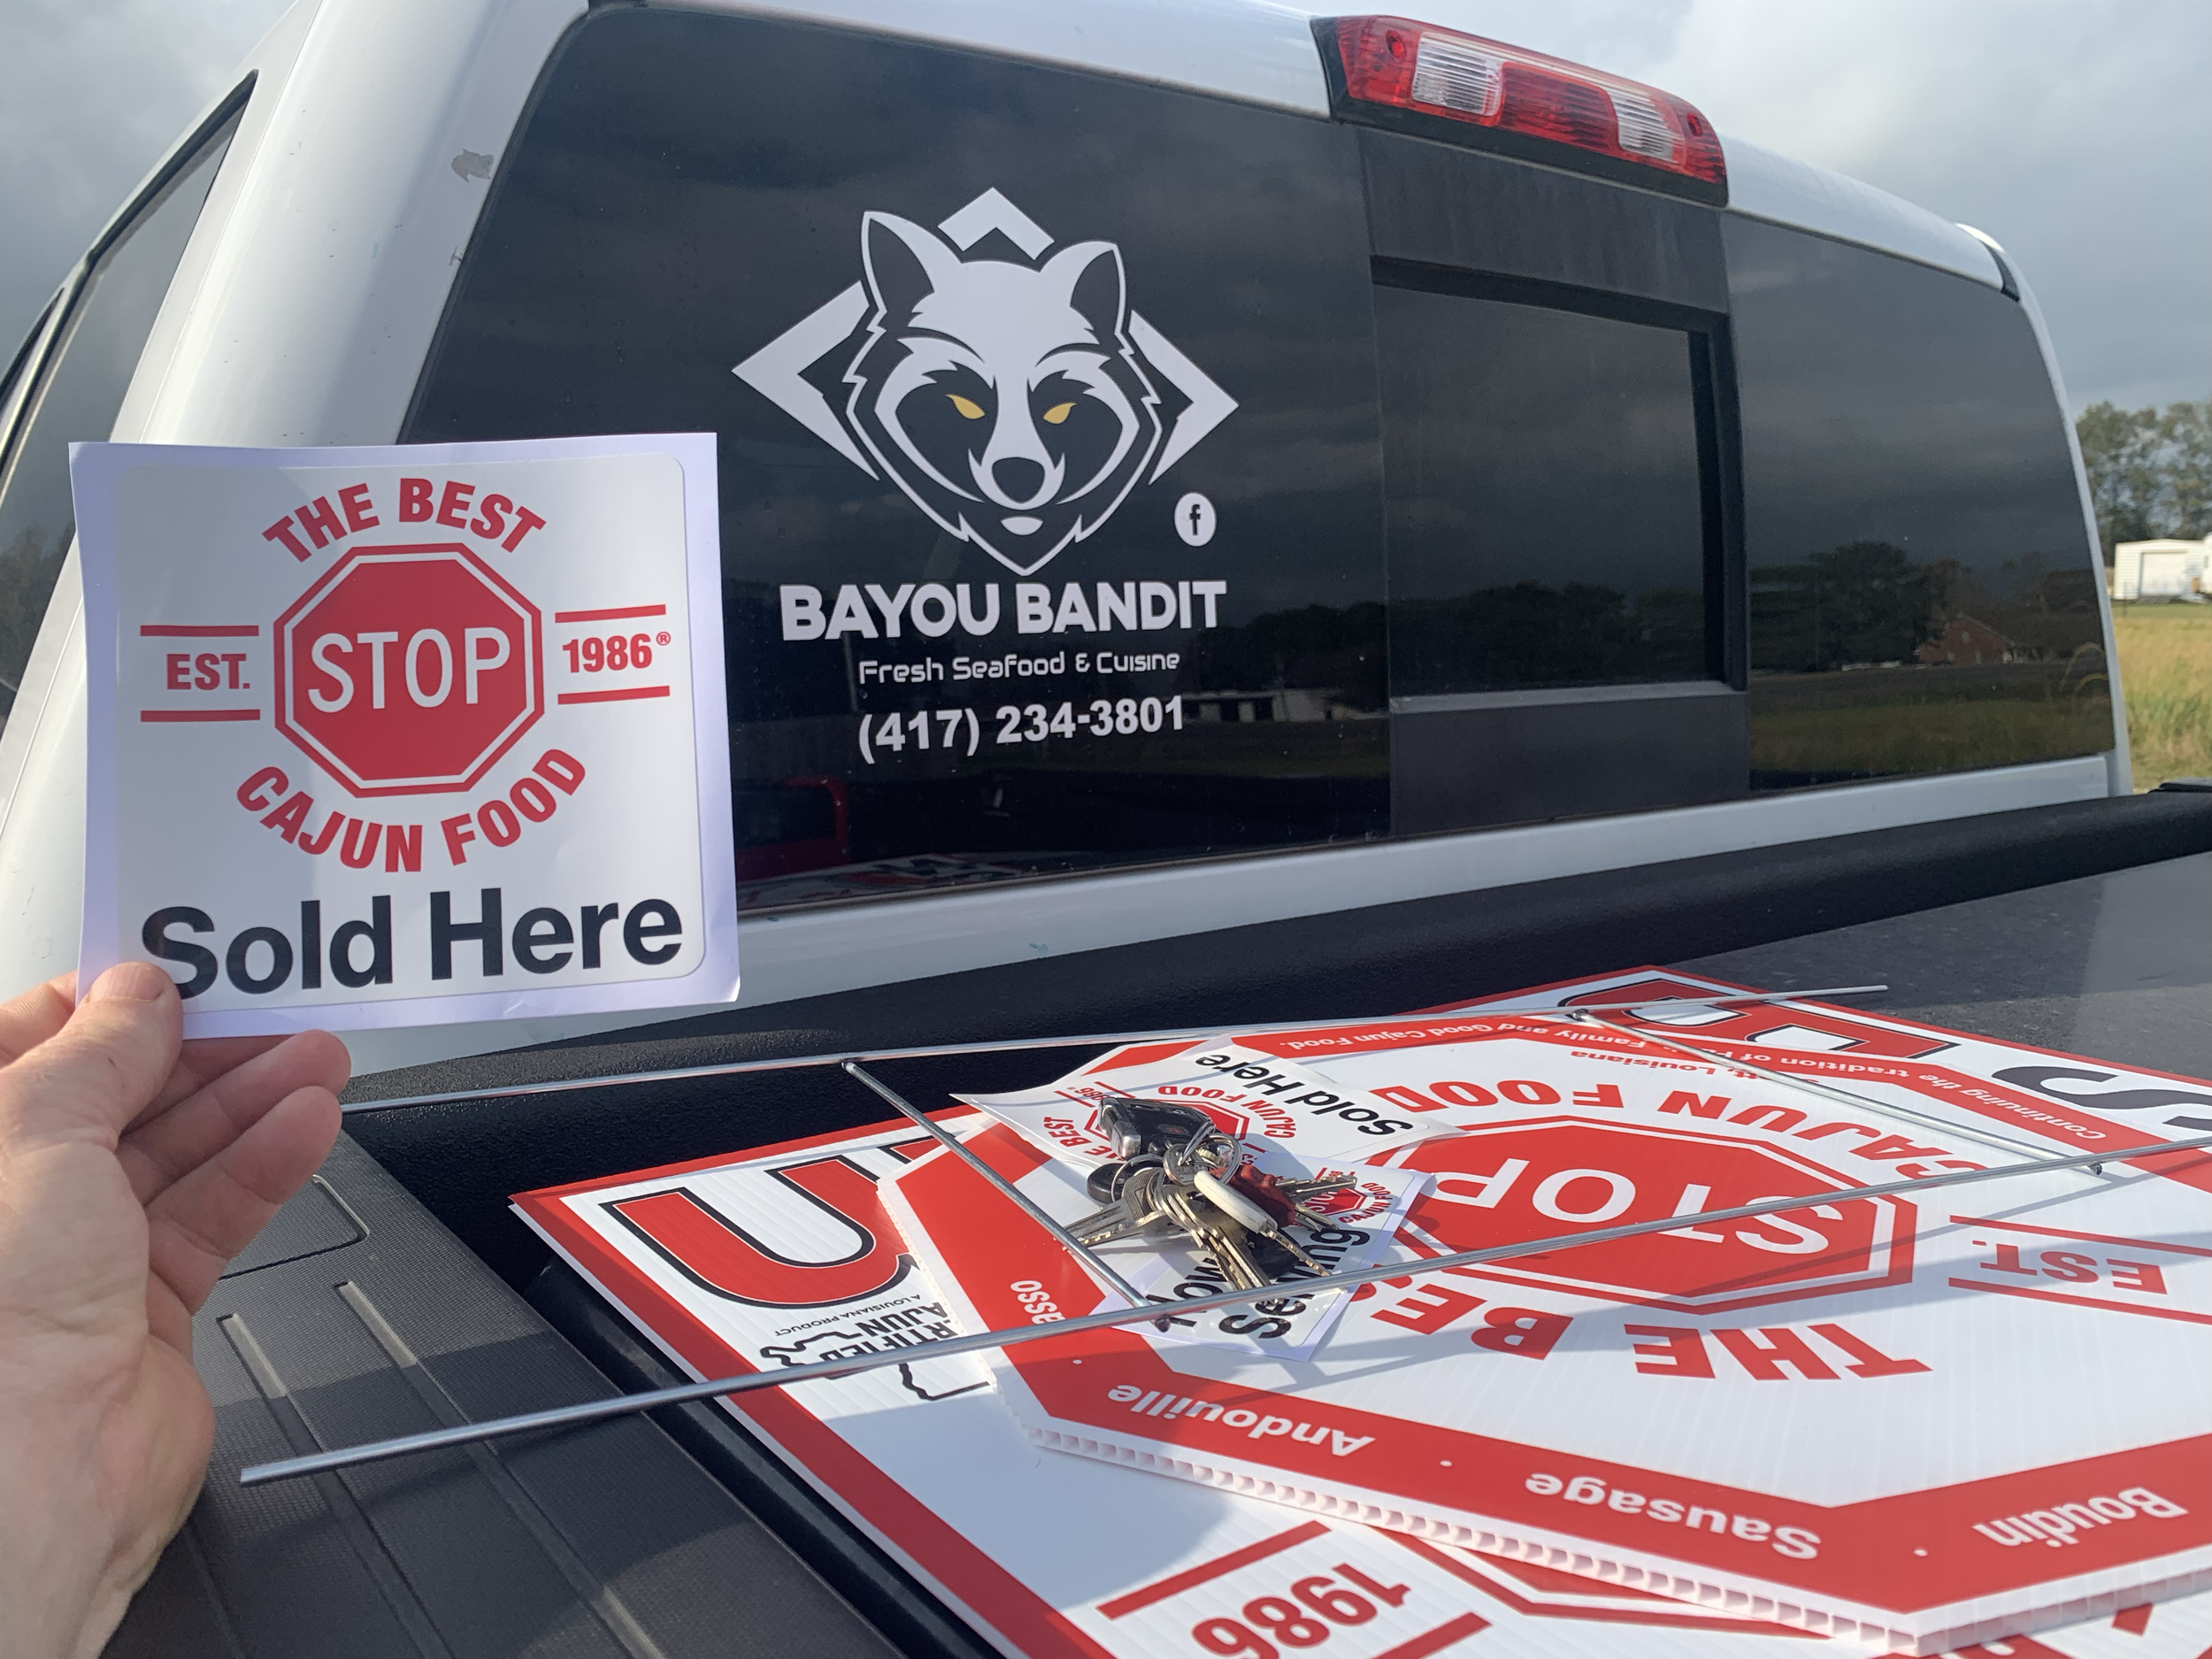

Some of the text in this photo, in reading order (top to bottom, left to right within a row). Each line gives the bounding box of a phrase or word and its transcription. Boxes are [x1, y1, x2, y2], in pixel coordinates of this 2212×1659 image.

[262, 478, 546, 563] THE BEST
[780, 580, 1228, 641] BAYOU BANDIT
[165, 653, 250, 690] EST.
[307, 627, 511, 713] STOP
[858, 651, 1181, 685] Fresh Seafood & Cuisine
[858, 695, 1184, 764] (417) 234-3801
[236, 749, 587, 872] CAJUN FOOD
[141, 887, 683, 1000] Sold Here
[1279, 1022, 1646, 1051] Family and Good Cajun Food.
[1571, 1050, 1716, 1075] Louisiana
[1780, 1057, 1909, 1078] tradition
[1918, 1073, 1962, 1089] the
[1157, 1086, 1297, 1139] CAJUN FOOD
[1194, 1054, 1414, 1136] Sold Here
[1368, 1079, 1624, 1113] FOOD
[1960, 1087, 2107, 1140] Continuing
[1043, 1117, 1093, 1148] BEST
[1657, 1090, 1991, 1181] CAJUN
[1338, 1182, 1393, 1224] CAJUN FOOD
[1424, 1157, 1845, 1255] STOP
[1972, 1240, 2168, 1295] EST.
[774, 1314, 841, 1337] PRODUCT
[840, 1296, 910, 1319] LOUISIANA
[855, 1302, 949, 1337] AJUN
[1010, 1280, 1066, 1325] asso
[1624, 1323, 1933, 1381] THE
[1108, 1385, 1376, 1457] Andouille
[1525, 1472, 1822, 1560] Sausage
[1971, 1486, 2189, 1548] Boudin
[1192, 1563, 1412, 1659] 1986
